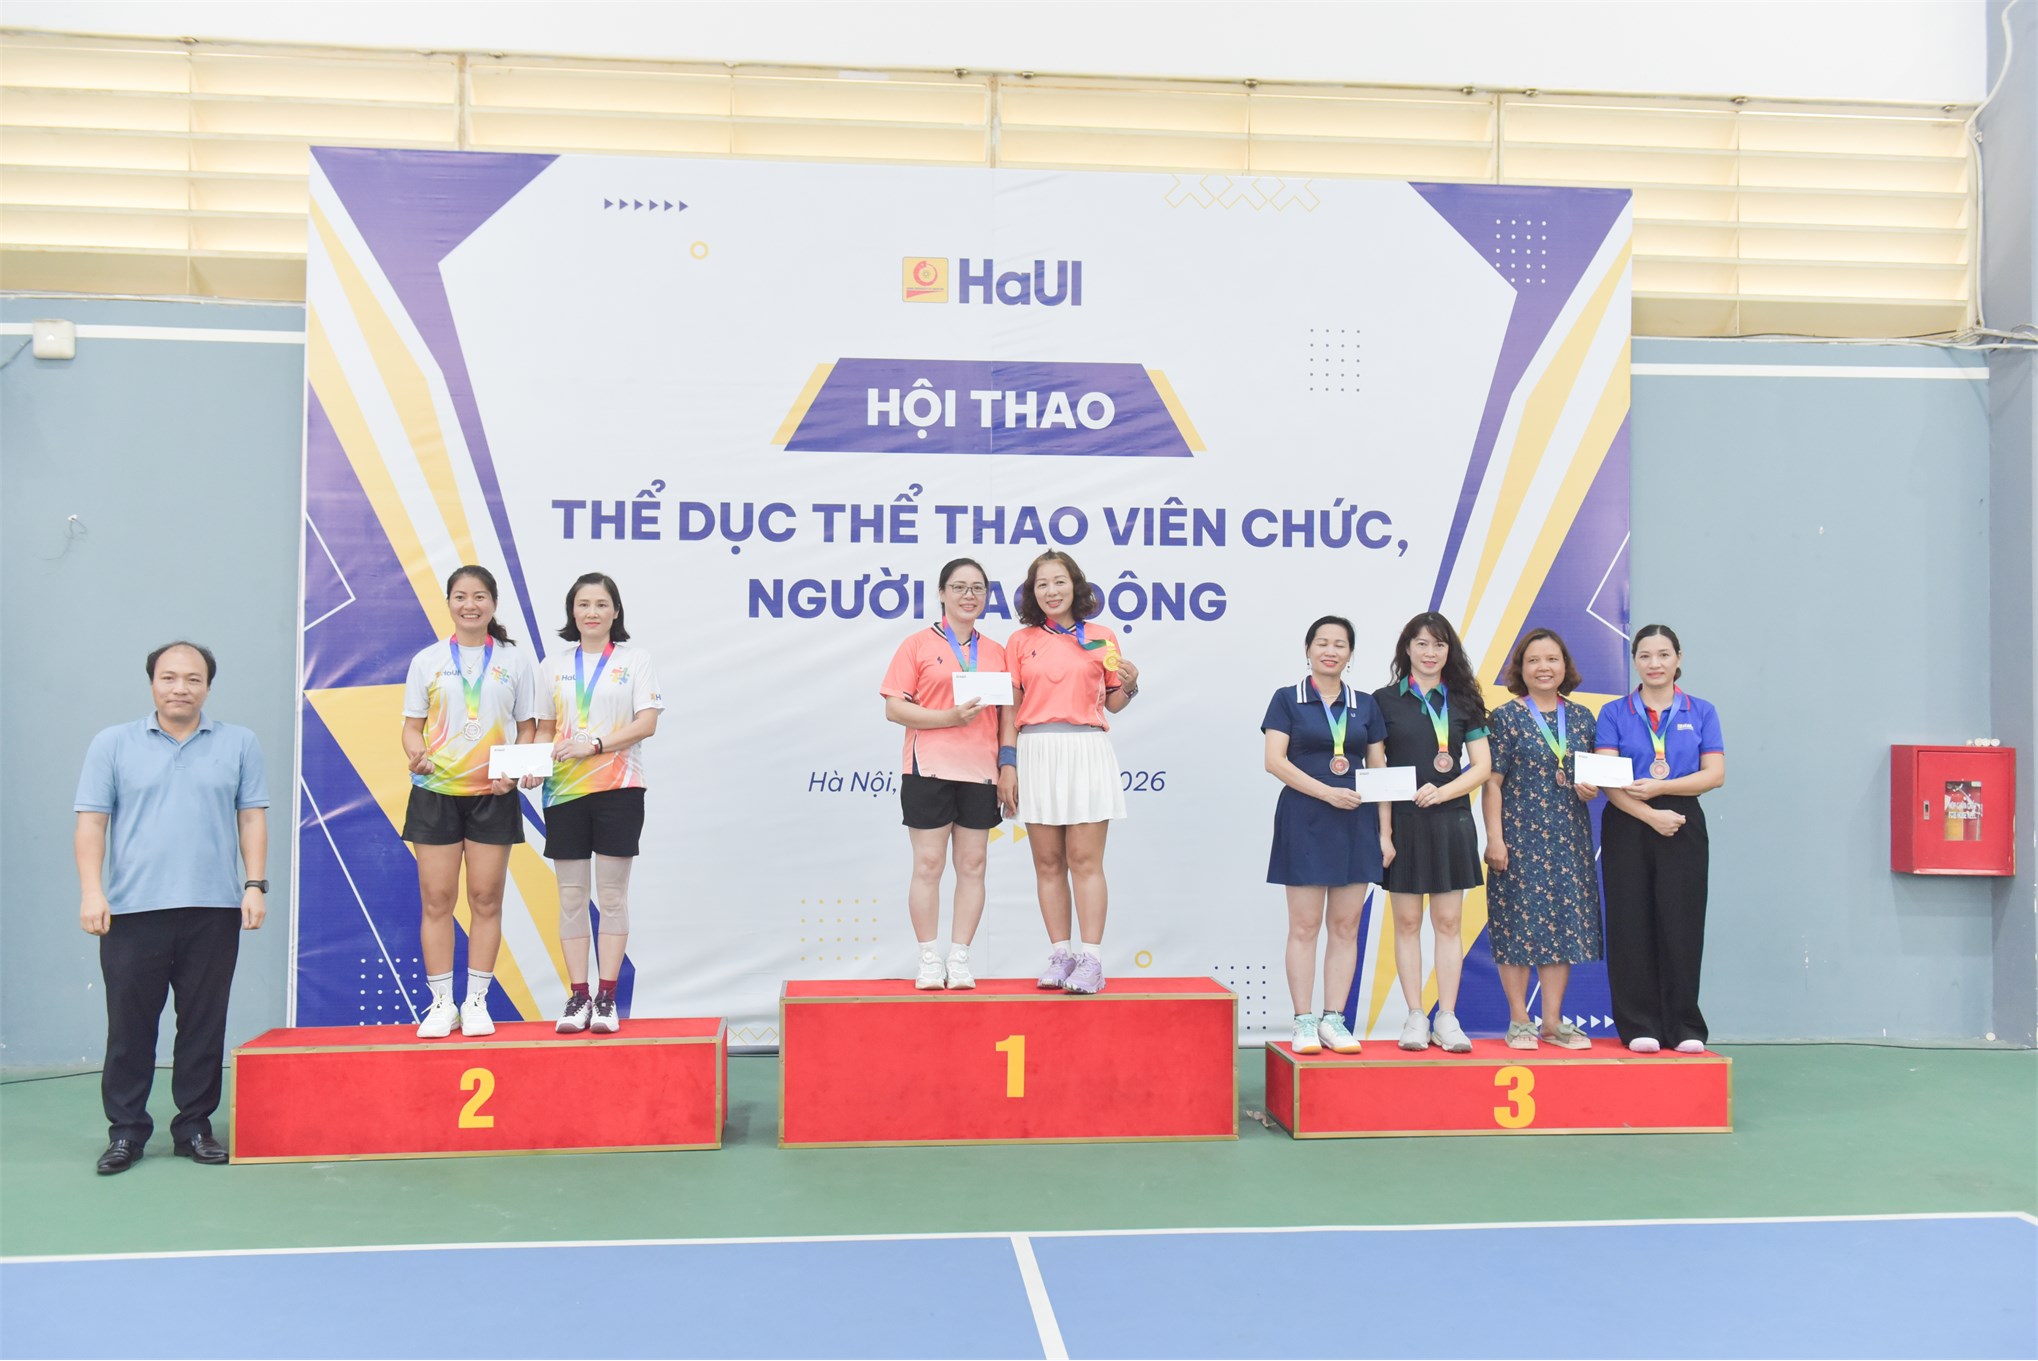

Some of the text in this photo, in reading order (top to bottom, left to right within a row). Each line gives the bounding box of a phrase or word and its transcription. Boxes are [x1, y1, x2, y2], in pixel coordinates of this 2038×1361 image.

[959, 258, 1083, 307] HaUI
[867, 378, 1116, 440] HỘI THAO
[552, 479, 1409, 557] THỂ DỤC THỂ THAO VIÊN CHỨC,
[748, 566, 925, 620] NGƯỜI
[808, 769, 1167, 798] Hà Nội, 026
[995, 1034, 1026, 1098] 1
[1493, 1065, 1536, 1128] 3
[458, 1067, 495, 1129] 2
